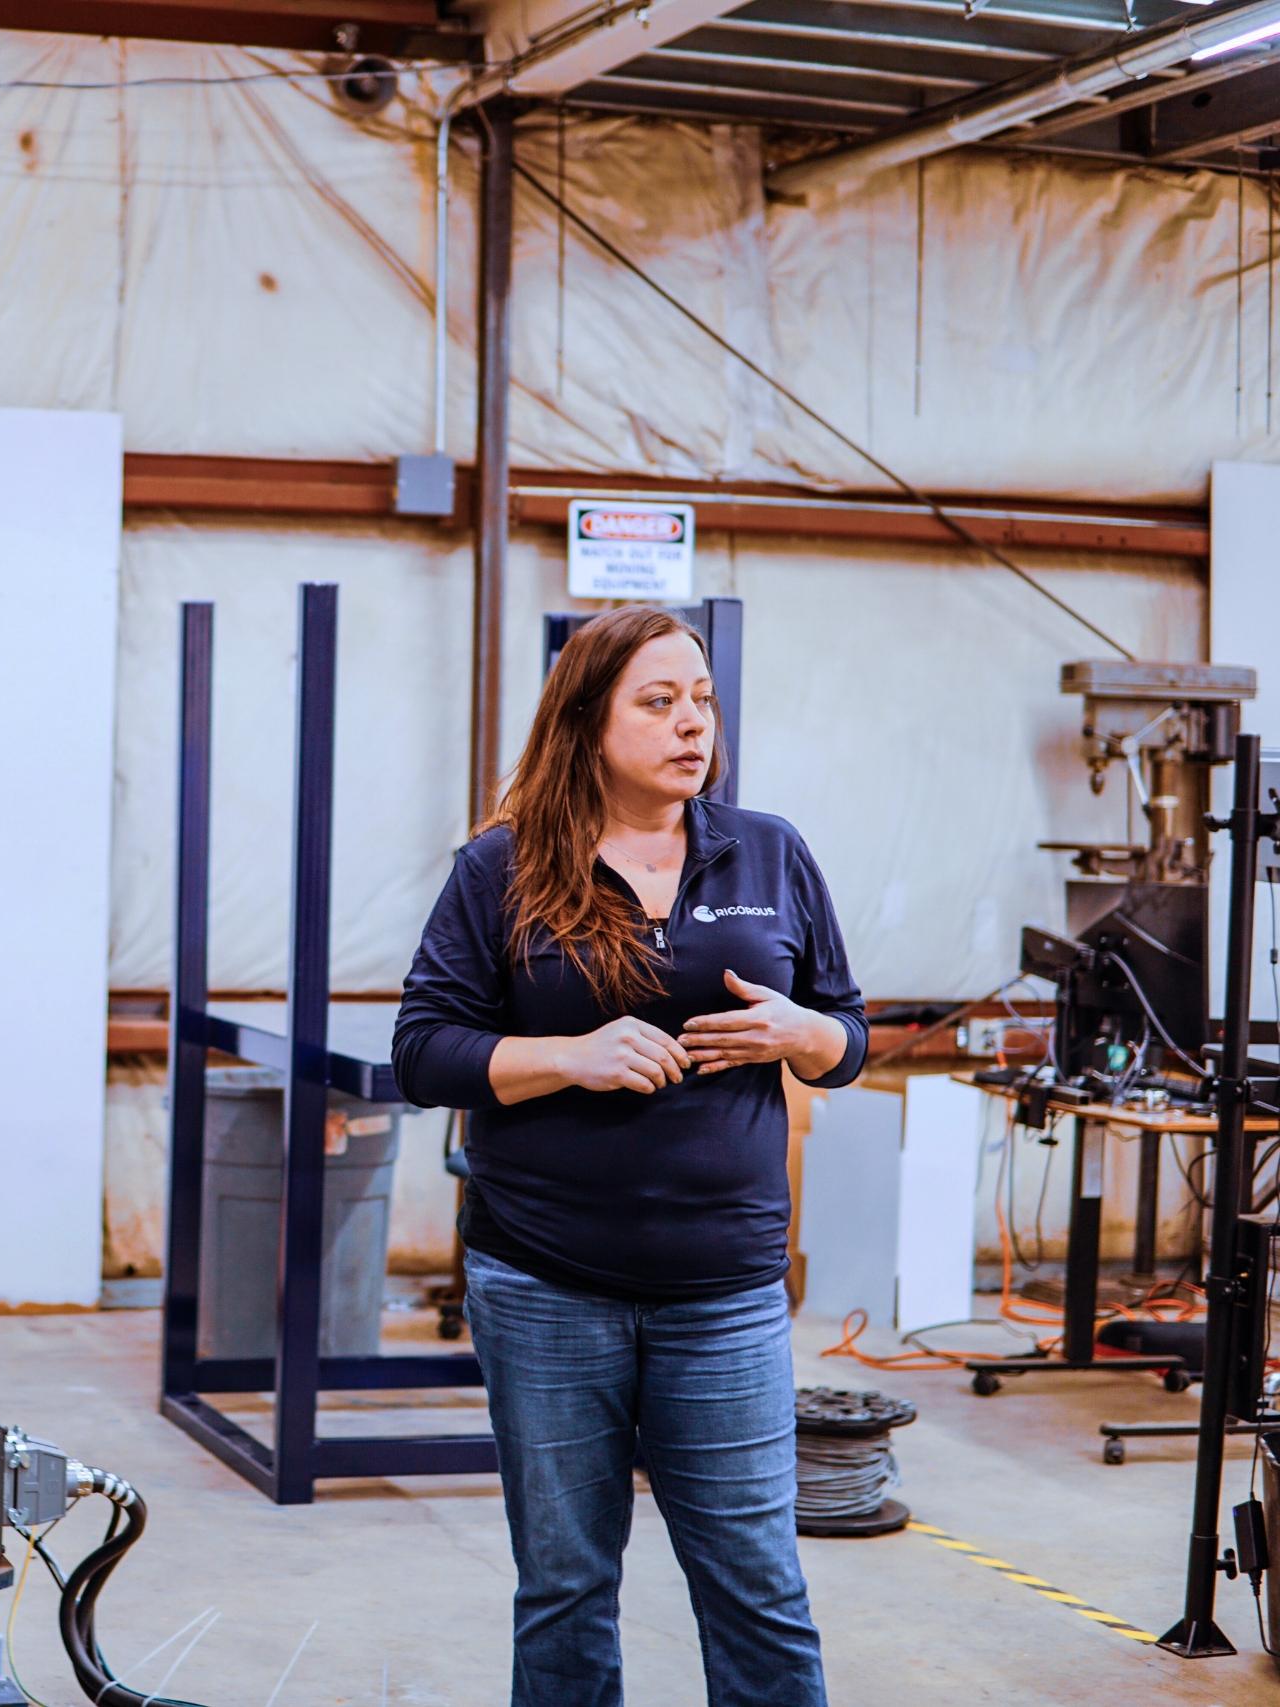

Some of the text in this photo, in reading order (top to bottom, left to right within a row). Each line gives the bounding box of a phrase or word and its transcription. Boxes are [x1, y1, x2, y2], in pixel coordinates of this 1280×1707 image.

[591, 515, 672, 536] DANGER
[581, 546, 682, 560] WATCH OUT FOR
[606, 563, 655, 575] MOVING
[592, 578, 667, 591] EQUIPMENT
[715, 905, 776, 917] RIGOROUS
